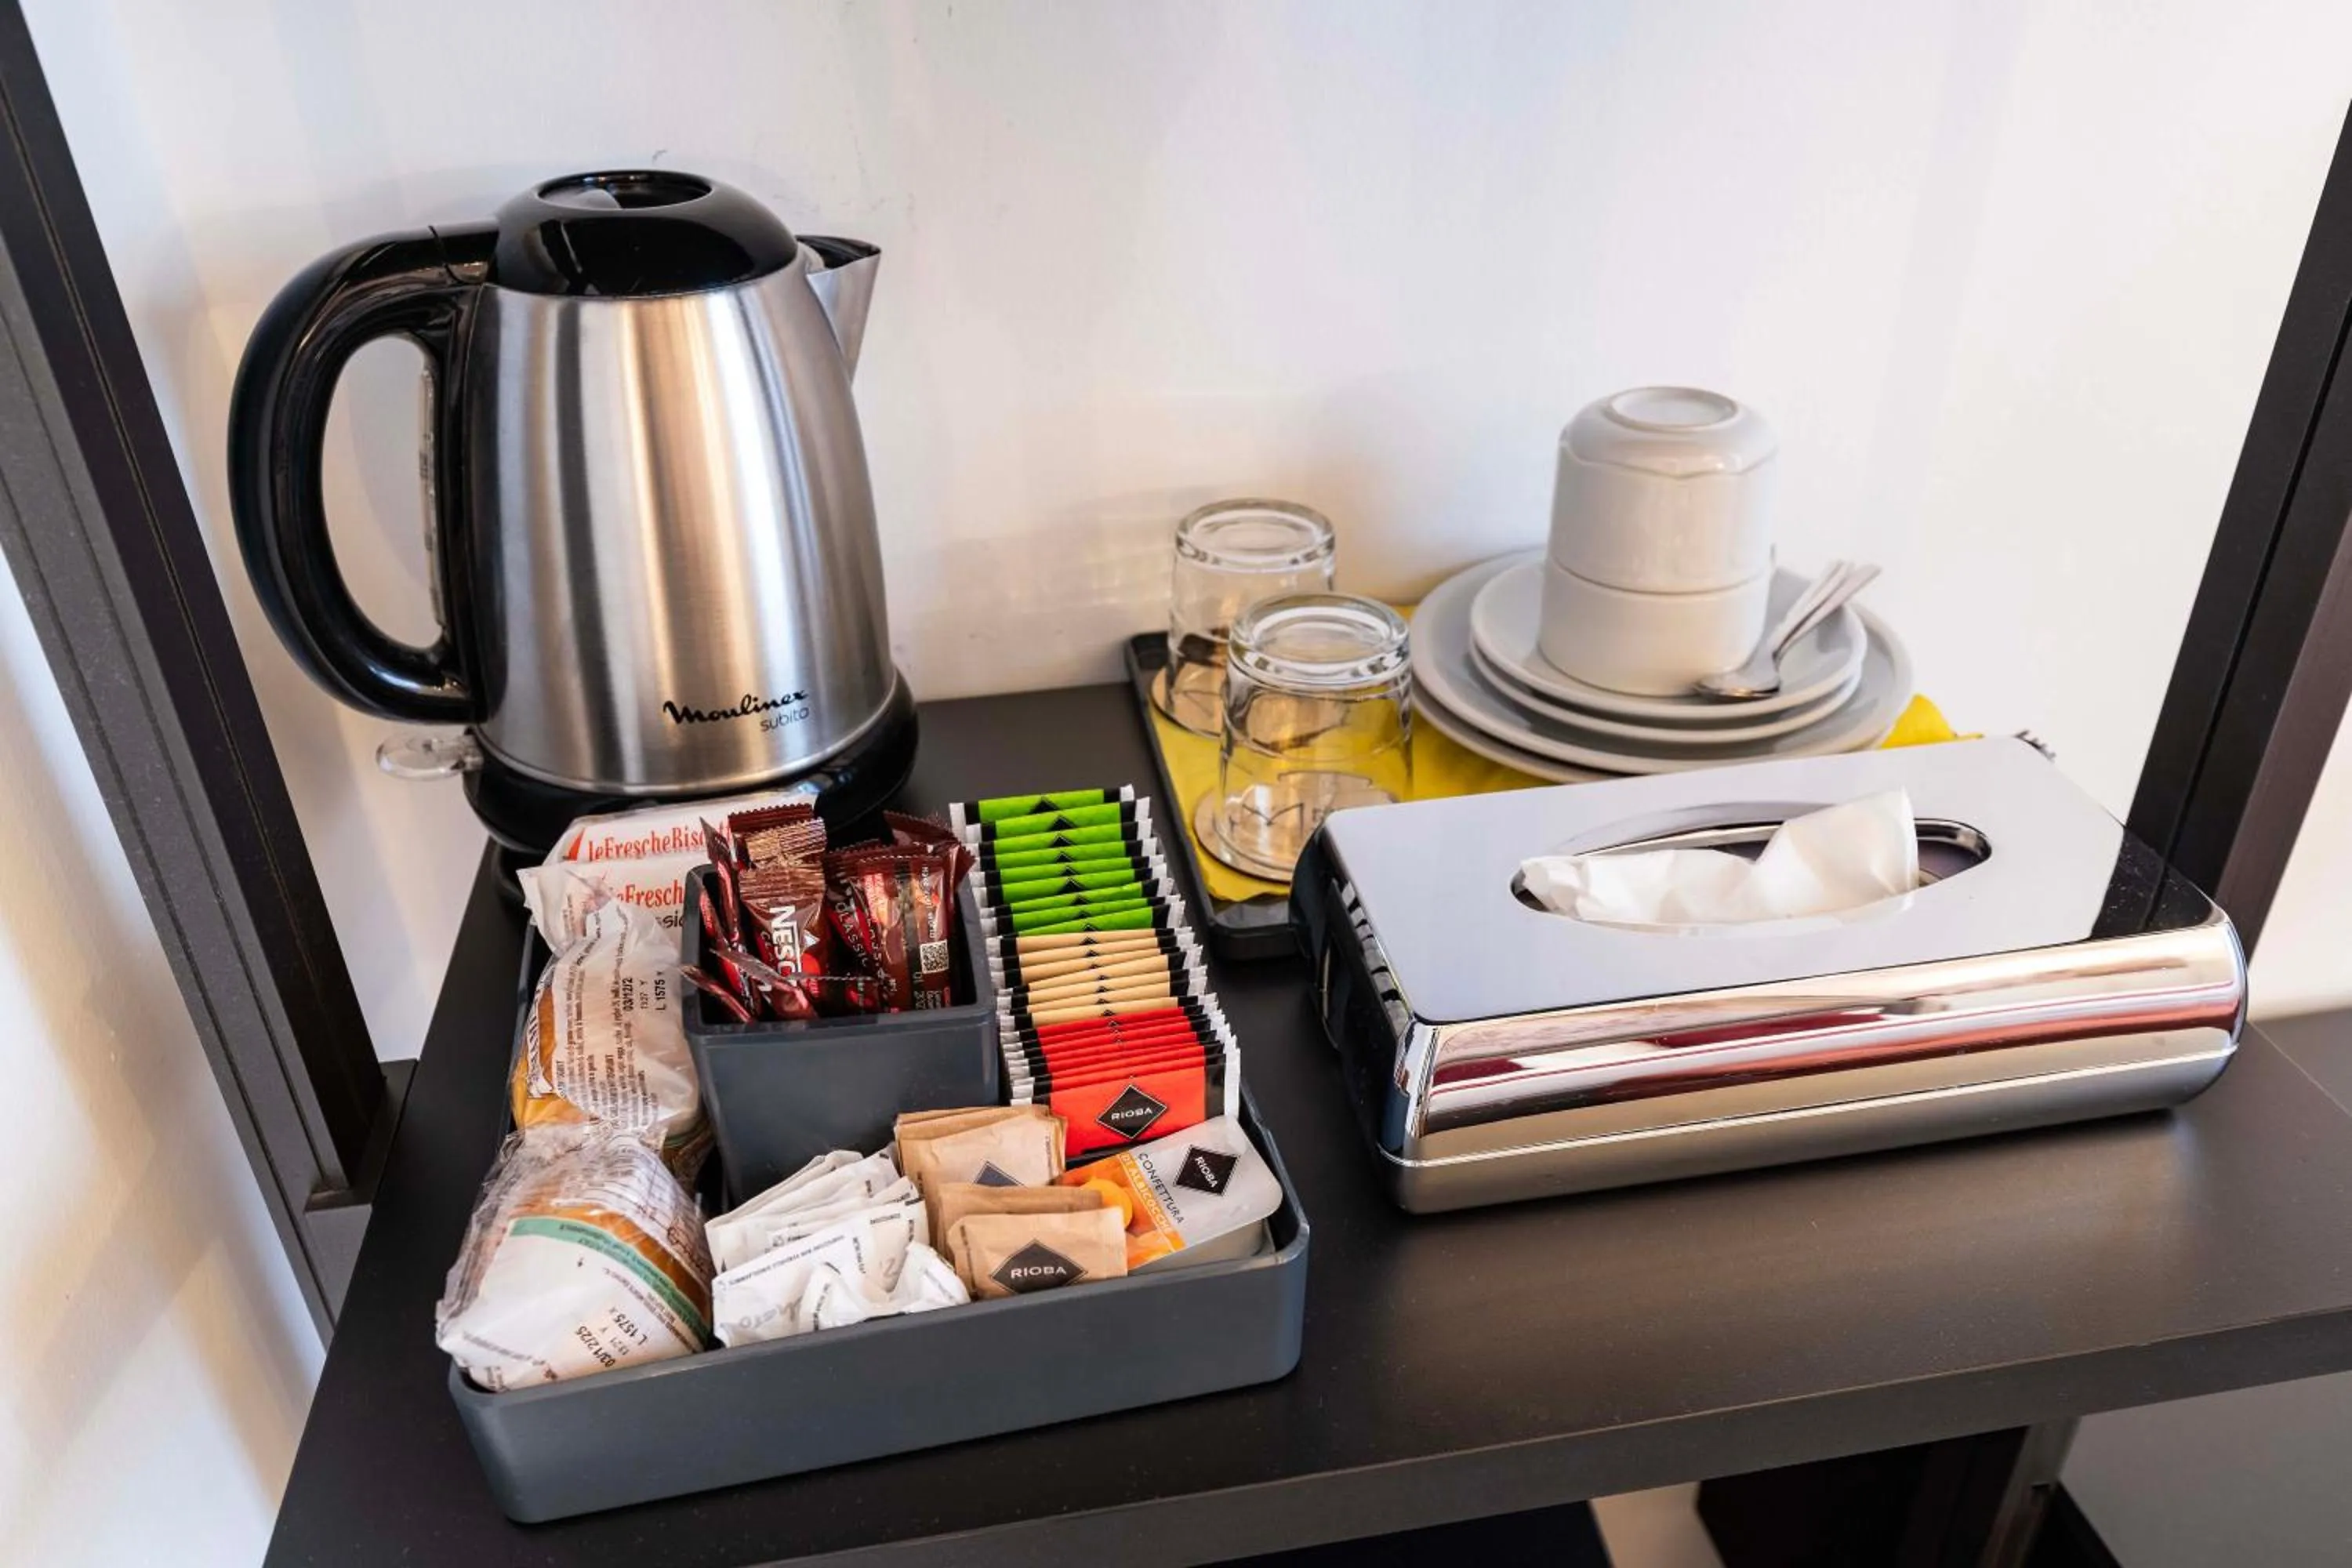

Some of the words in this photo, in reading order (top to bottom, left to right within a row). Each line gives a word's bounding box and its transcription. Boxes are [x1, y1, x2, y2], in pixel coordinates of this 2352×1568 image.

[662, 689, 808, 724] Moulinex
[760, 706, 810, 732] subito
[769, 905, 802, 985] NESC
[655, 979, 665, 1000] 1575
[1112, 1107, 1153, 1120] RIOBA
[1195, 1156, 1218, 1187] RIOBA
[1138, 1152, 1184, 1223] CONFETTURA
[1011, 1266, 1067, 1279] RIOBA
[613, 1313, 639, 1337] 1575
[575, 1326, 616, 1367] 03/12/25
